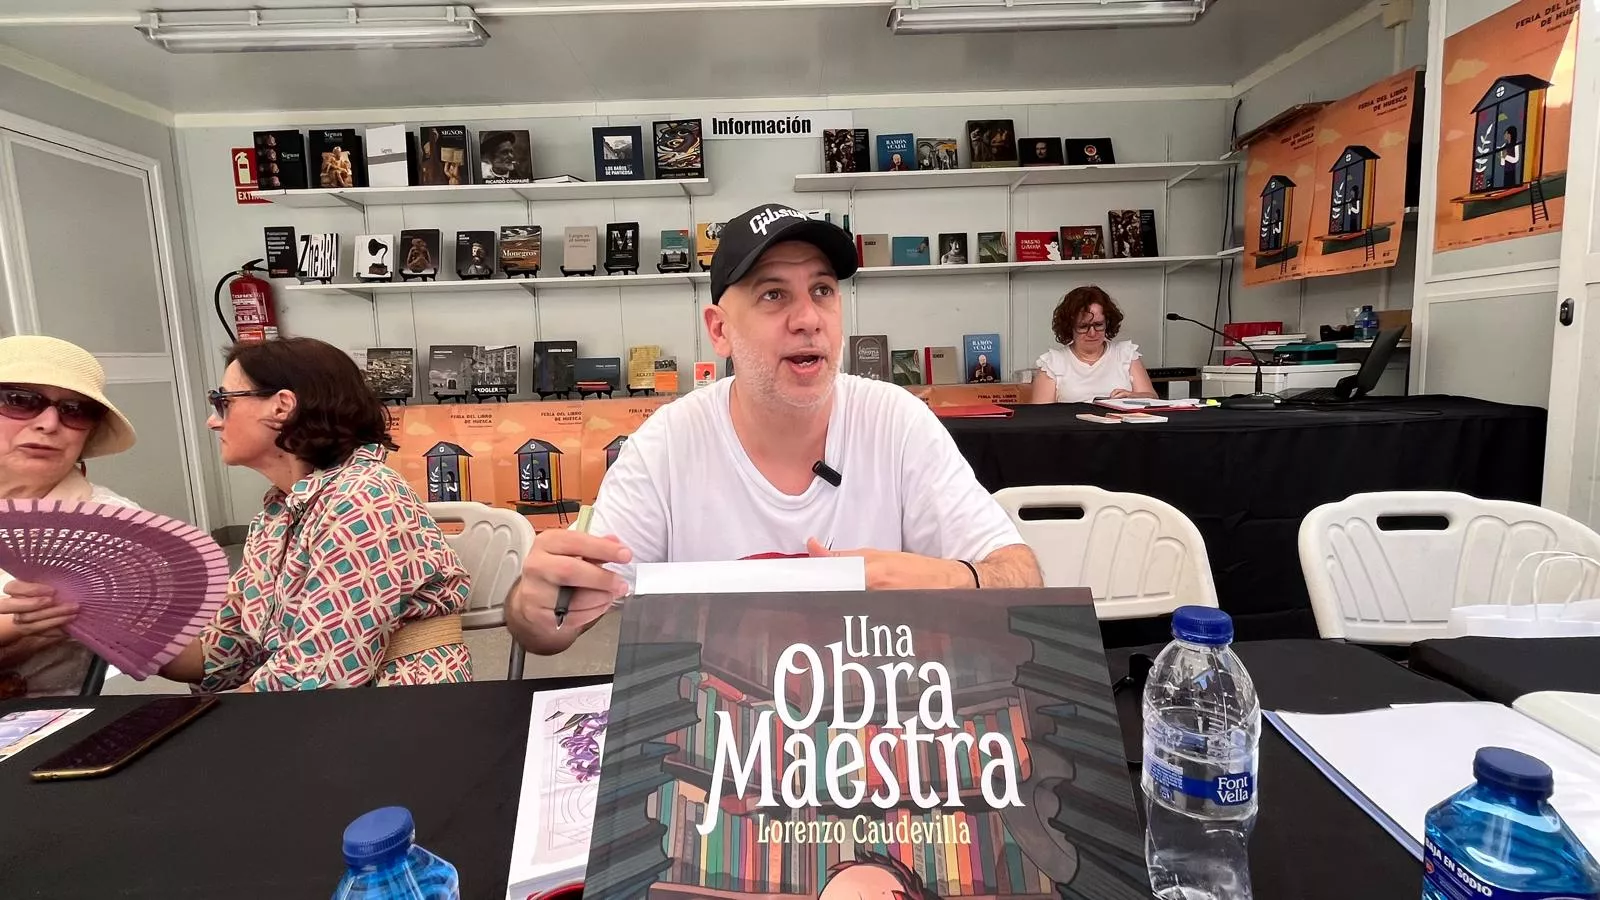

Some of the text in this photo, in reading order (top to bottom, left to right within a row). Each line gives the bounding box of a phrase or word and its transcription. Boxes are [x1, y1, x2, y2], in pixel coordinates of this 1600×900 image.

[1515, 12, 1541, 29] FERIA
[1545, 3, 1561, 16] DEL
[1541, 16, 1552, 27] DE
[1556, 4, 1580, 20] HUES
[712, 116, 811, 135] Información
[502, 249, 537, 258] Monegros
[844, 616, 915, 658] Una
[773, 641, 960, 731] Obra
[696, 711, 1026, 835] Maestra
[1218, 776, 1248, 790] Font
[1217, 788, 1249, 803] Vella
[757, 815, 971, 844] Lorenzo Caudevilla
[1444, 856, 1455, 872] EN
[1457, 867, 1493, 897] SODIO
